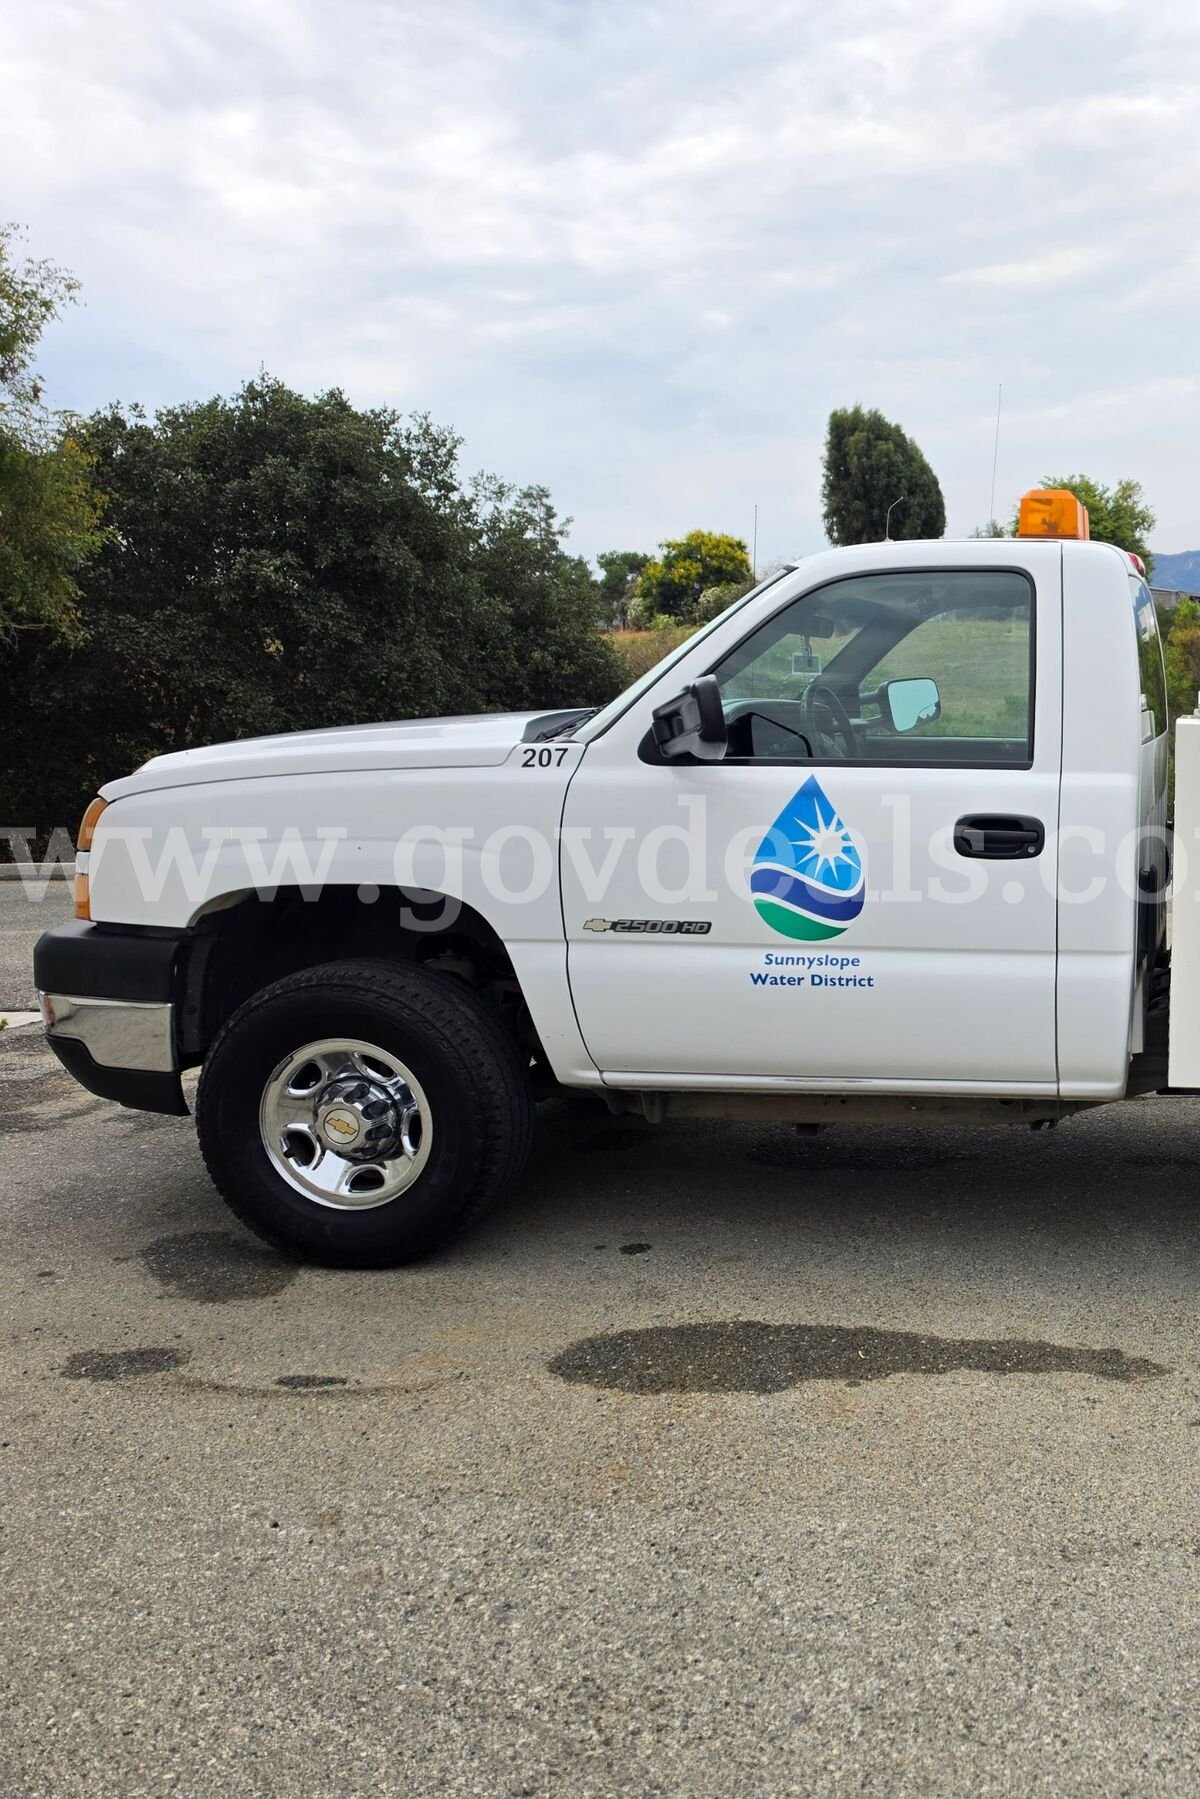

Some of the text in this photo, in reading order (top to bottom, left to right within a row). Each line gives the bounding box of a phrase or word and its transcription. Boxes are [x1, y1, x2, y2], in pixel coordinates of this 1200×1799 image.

[521, 748, 569, 768] 207
[615, 920, 709, 933] 2500 HD
[764, 953, 861, 970] Sunnyslope
[750, 973, 875, 988] Water District
